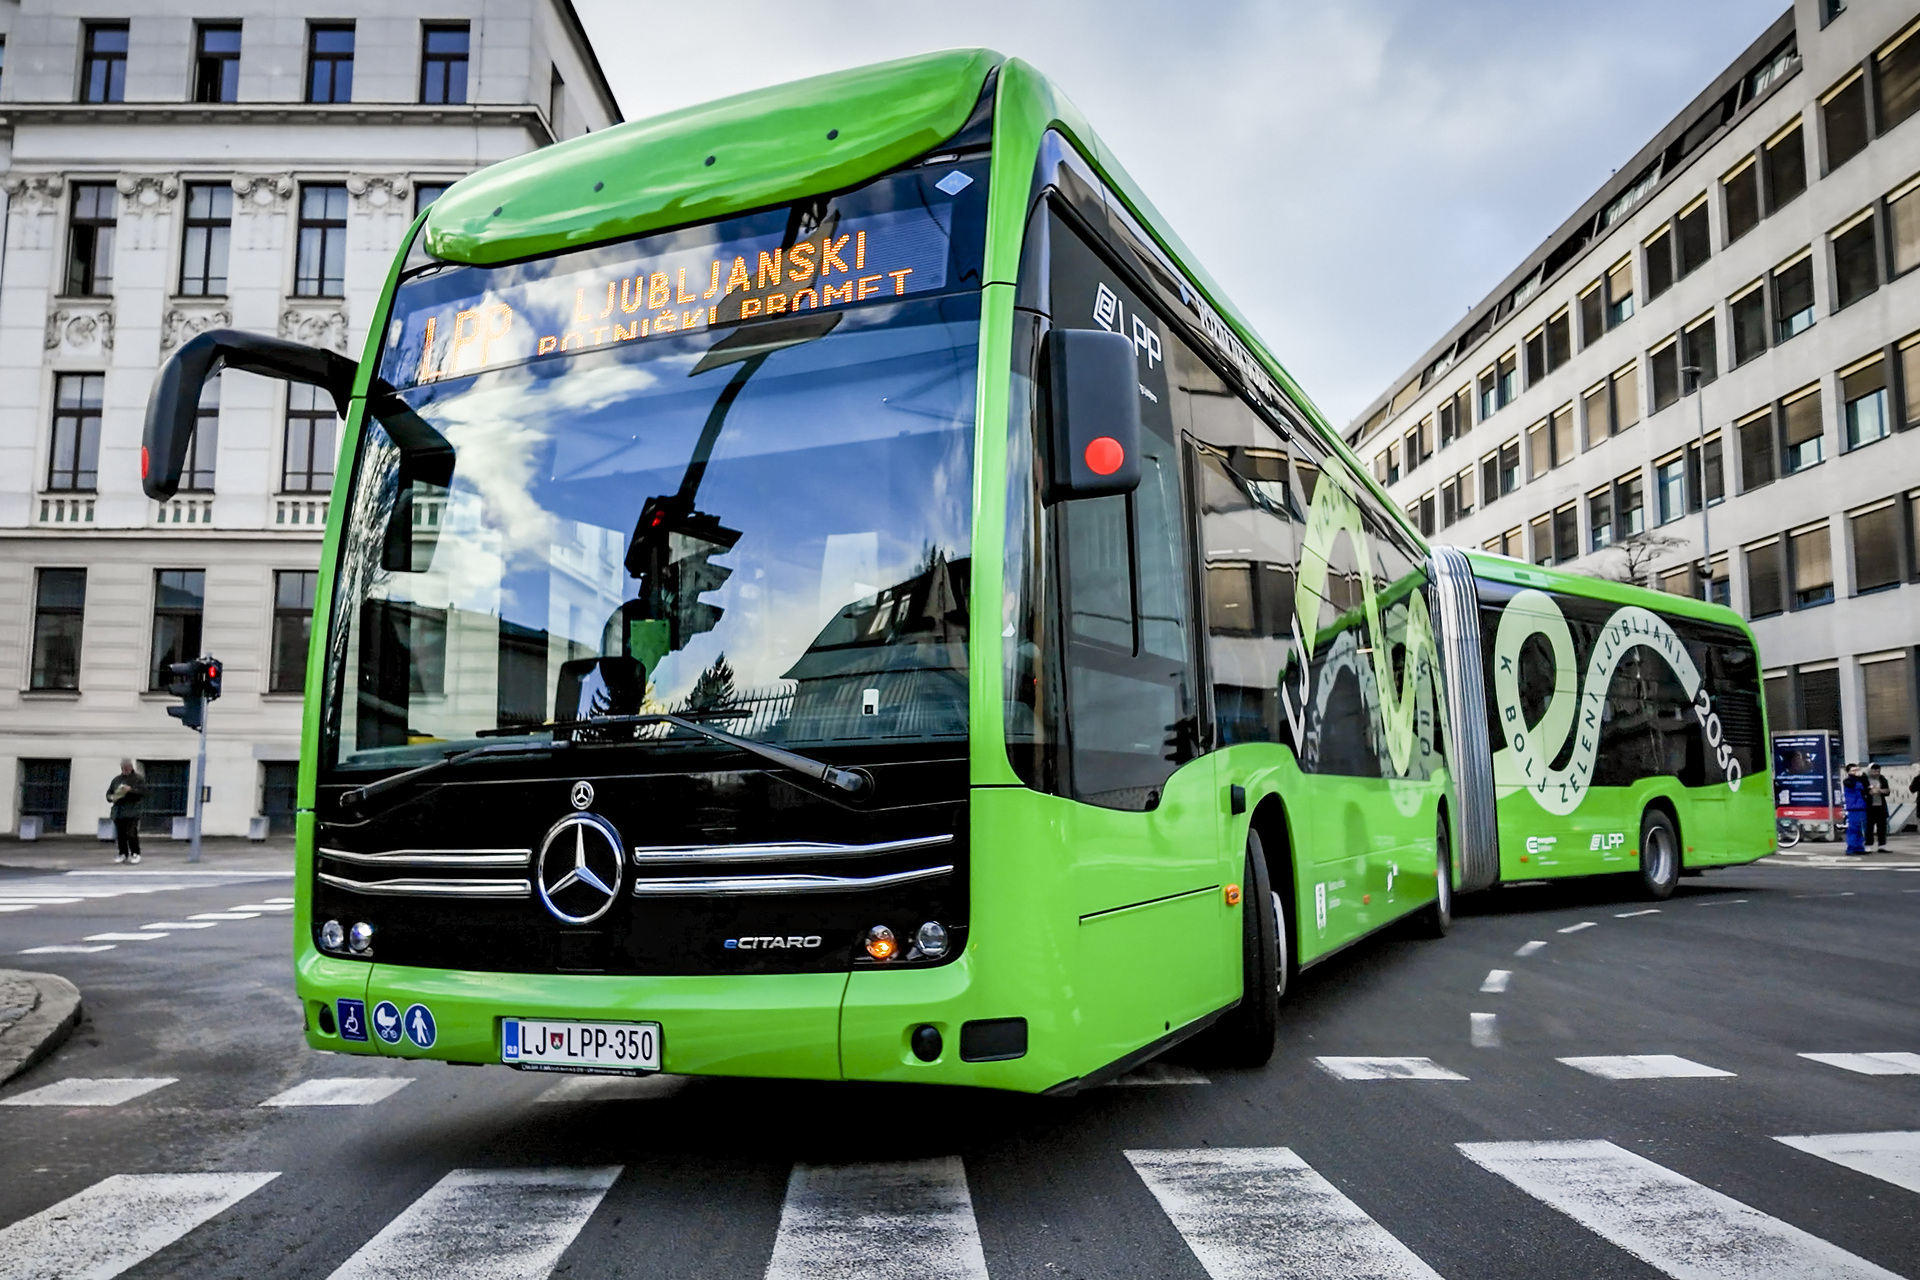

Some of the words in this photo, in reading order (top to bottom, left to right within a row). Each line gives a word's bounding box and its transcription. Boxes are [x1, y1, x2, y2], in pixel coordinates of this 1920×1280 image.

[575, 231, 866, 323] LJUBLJANSKI
[741, 268, 913, 319] PROMET
[420, 303, 513, 382] LPP
[1500, 655, 1512, 675] K
[1505, 705, 1546, 793] BOLJ
[1559, 692, 1599, 803] ZELENI
[1602, 832, 1624, 850] LPP
[724, 936, 822, 949] eCITARO
[522, 1026, 547, 1055] LJ
[567, 1028, 653, 1060] LPP-350
